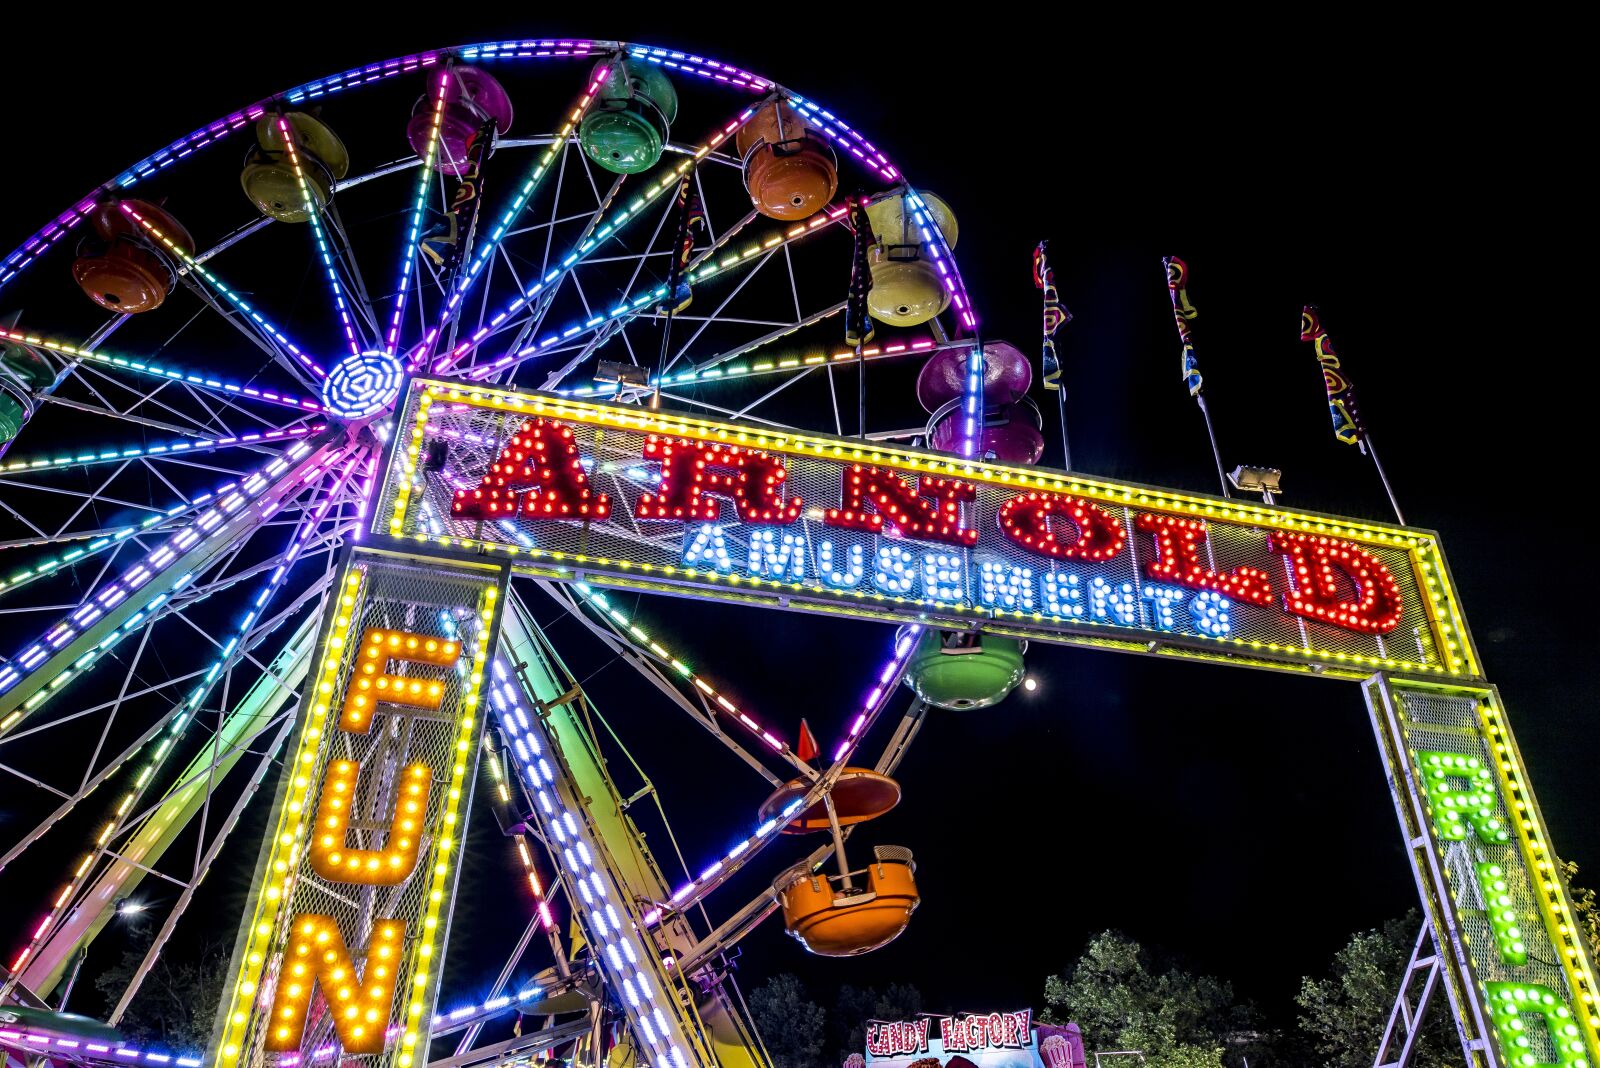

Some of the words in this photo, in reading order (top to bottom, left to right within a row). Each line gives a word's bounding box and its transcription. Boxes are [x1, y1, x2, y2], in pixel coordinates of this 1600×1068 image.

[450, 418, 1402, 635] ARNOLD
[681, 523, 1232, 639] AMUSEMENTS
[263, 627, 462, 1054] FUN
[866, 1017, 929, 1055] CANDY
[940, 1008, 1032, 1051] FACTORY
